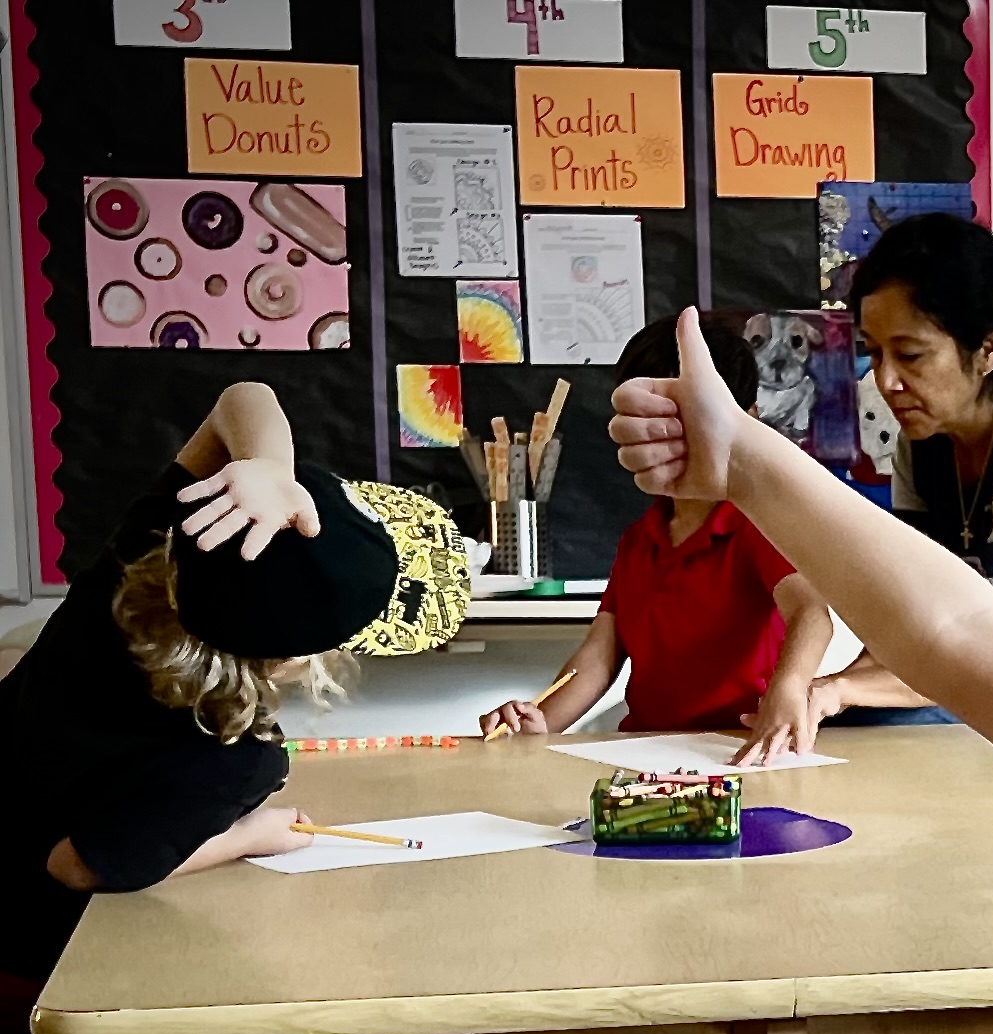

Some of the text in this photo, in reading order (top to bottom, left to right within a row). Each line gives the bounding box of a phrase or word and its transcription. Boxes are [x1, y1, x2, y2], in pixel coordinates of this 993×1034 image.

[808, 9, 870, 68] 5th
[210, 63, 305, 106] Value
[745, 79, 809, 118] Grid
[202, 112, 331, 155] Donuts
[532, 92, 637, 138] Radial
[550, 145, 638, 191] Prints
[729, 126, 847, 182] Drawing
